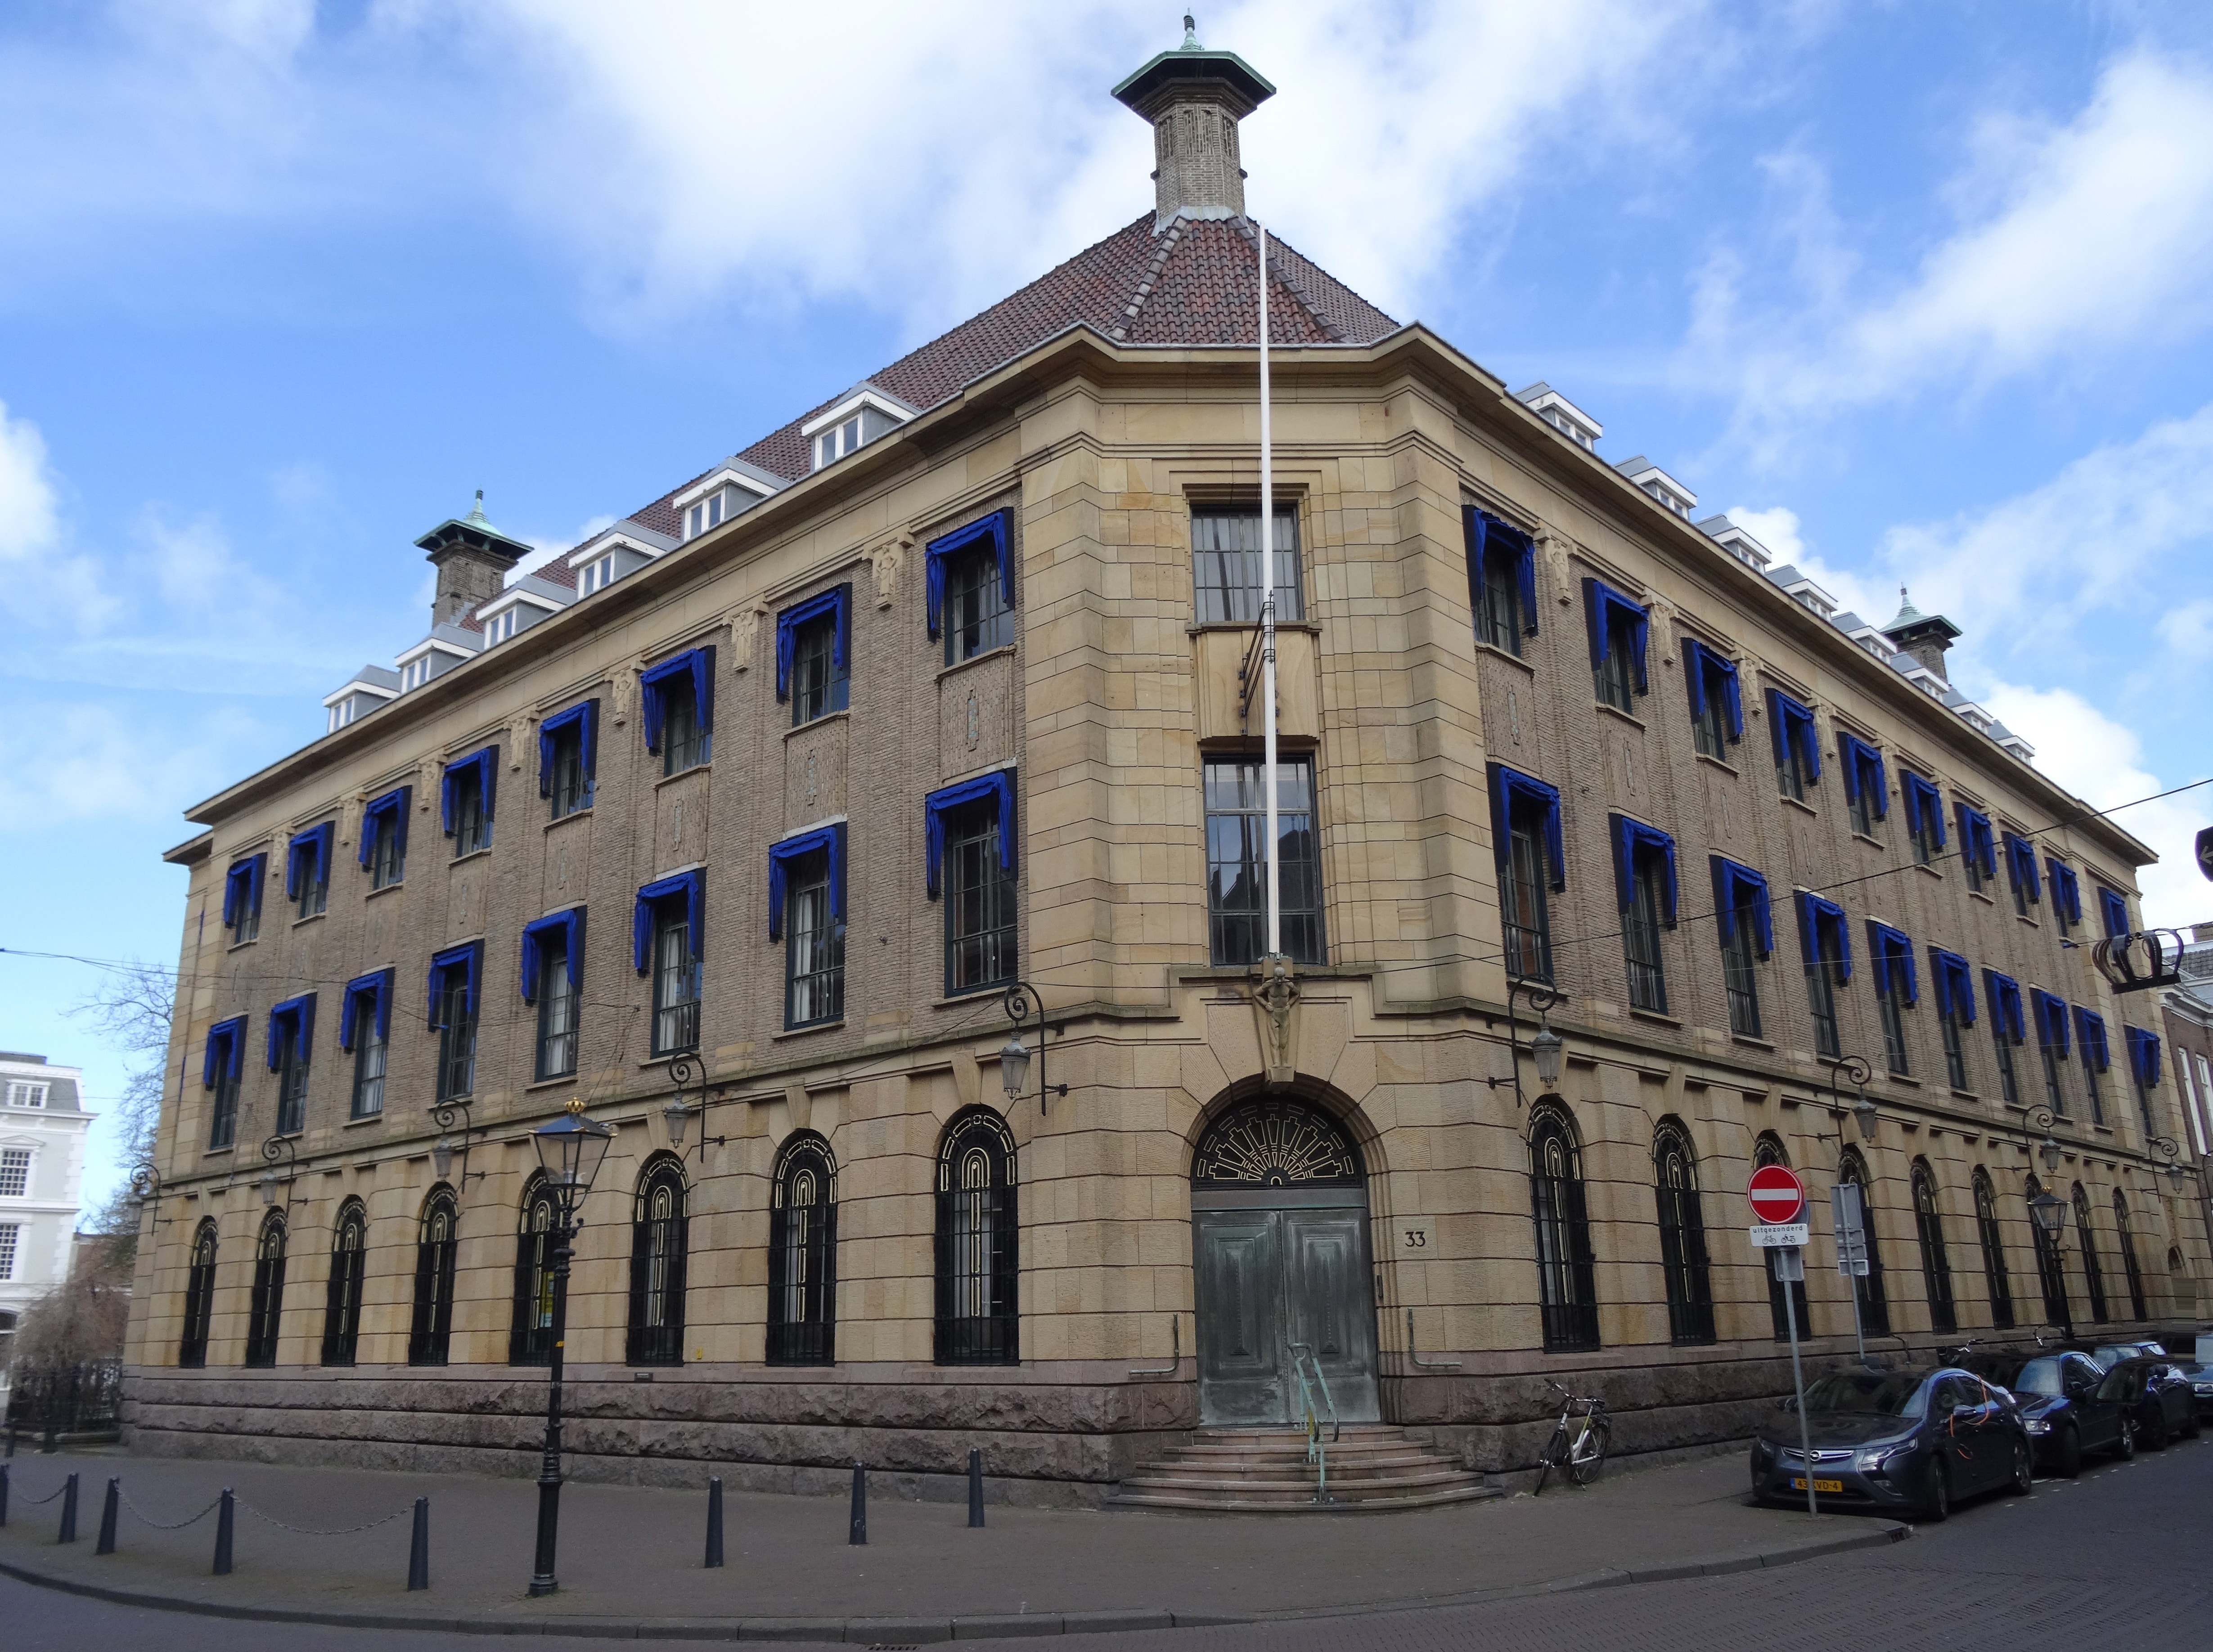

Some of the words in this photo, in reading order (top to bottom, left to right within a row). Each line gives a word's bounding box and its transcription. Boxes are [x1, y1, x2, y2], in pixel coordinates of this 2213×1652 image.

[1753, 1225, 1803, 1234] uitgezonderd
[1405, 1231, 1426, 1247] 33
[1798, 1480, 1838, 1490] 43VD-4
